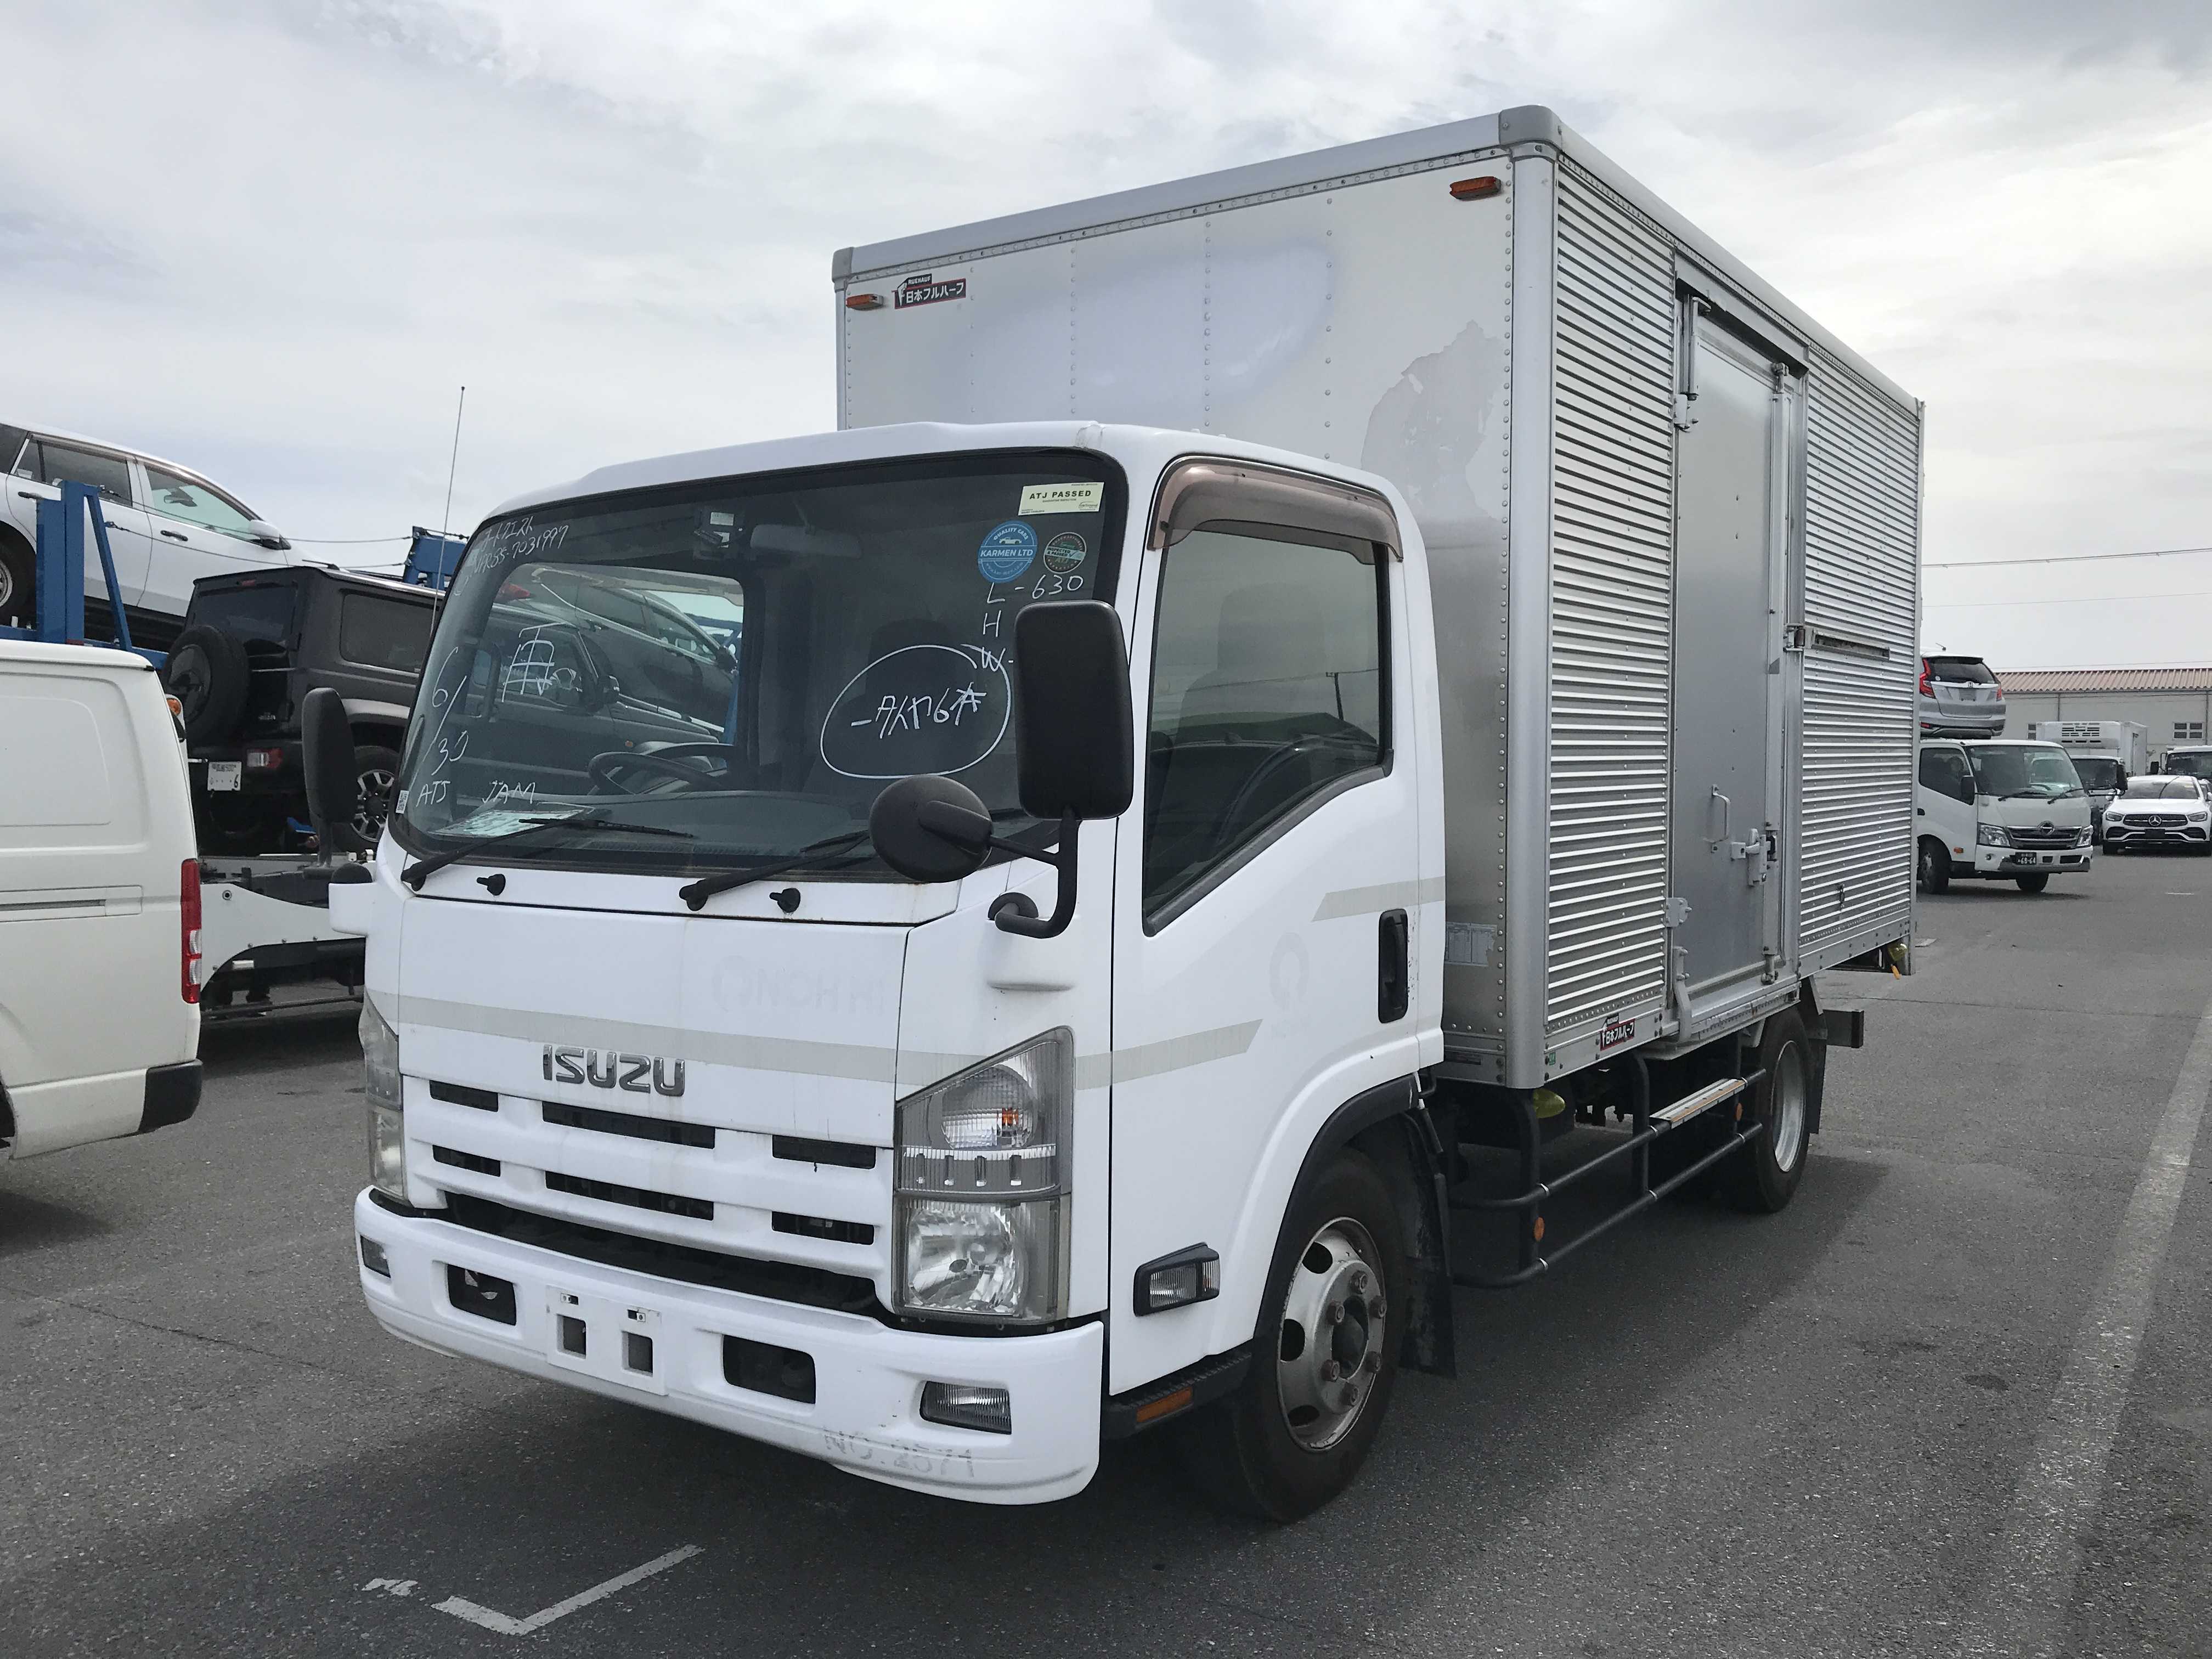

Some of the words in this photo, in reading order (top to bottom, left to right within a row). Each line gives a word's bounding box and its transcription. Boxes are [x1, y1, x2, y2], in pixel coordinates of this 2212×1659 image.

[906, 281, 964, 304] 日本フルハーフ
[1052, 490, 1092, 498] PASSED
[994, 527, 1017, 540] QUALITY
[980, 549, 1017, 557] KARMEN
[983, 610, 1002, 637] H
[416, 780, 451, 808] ATJ
[542, 1044, 686, 1097] ISUZU
